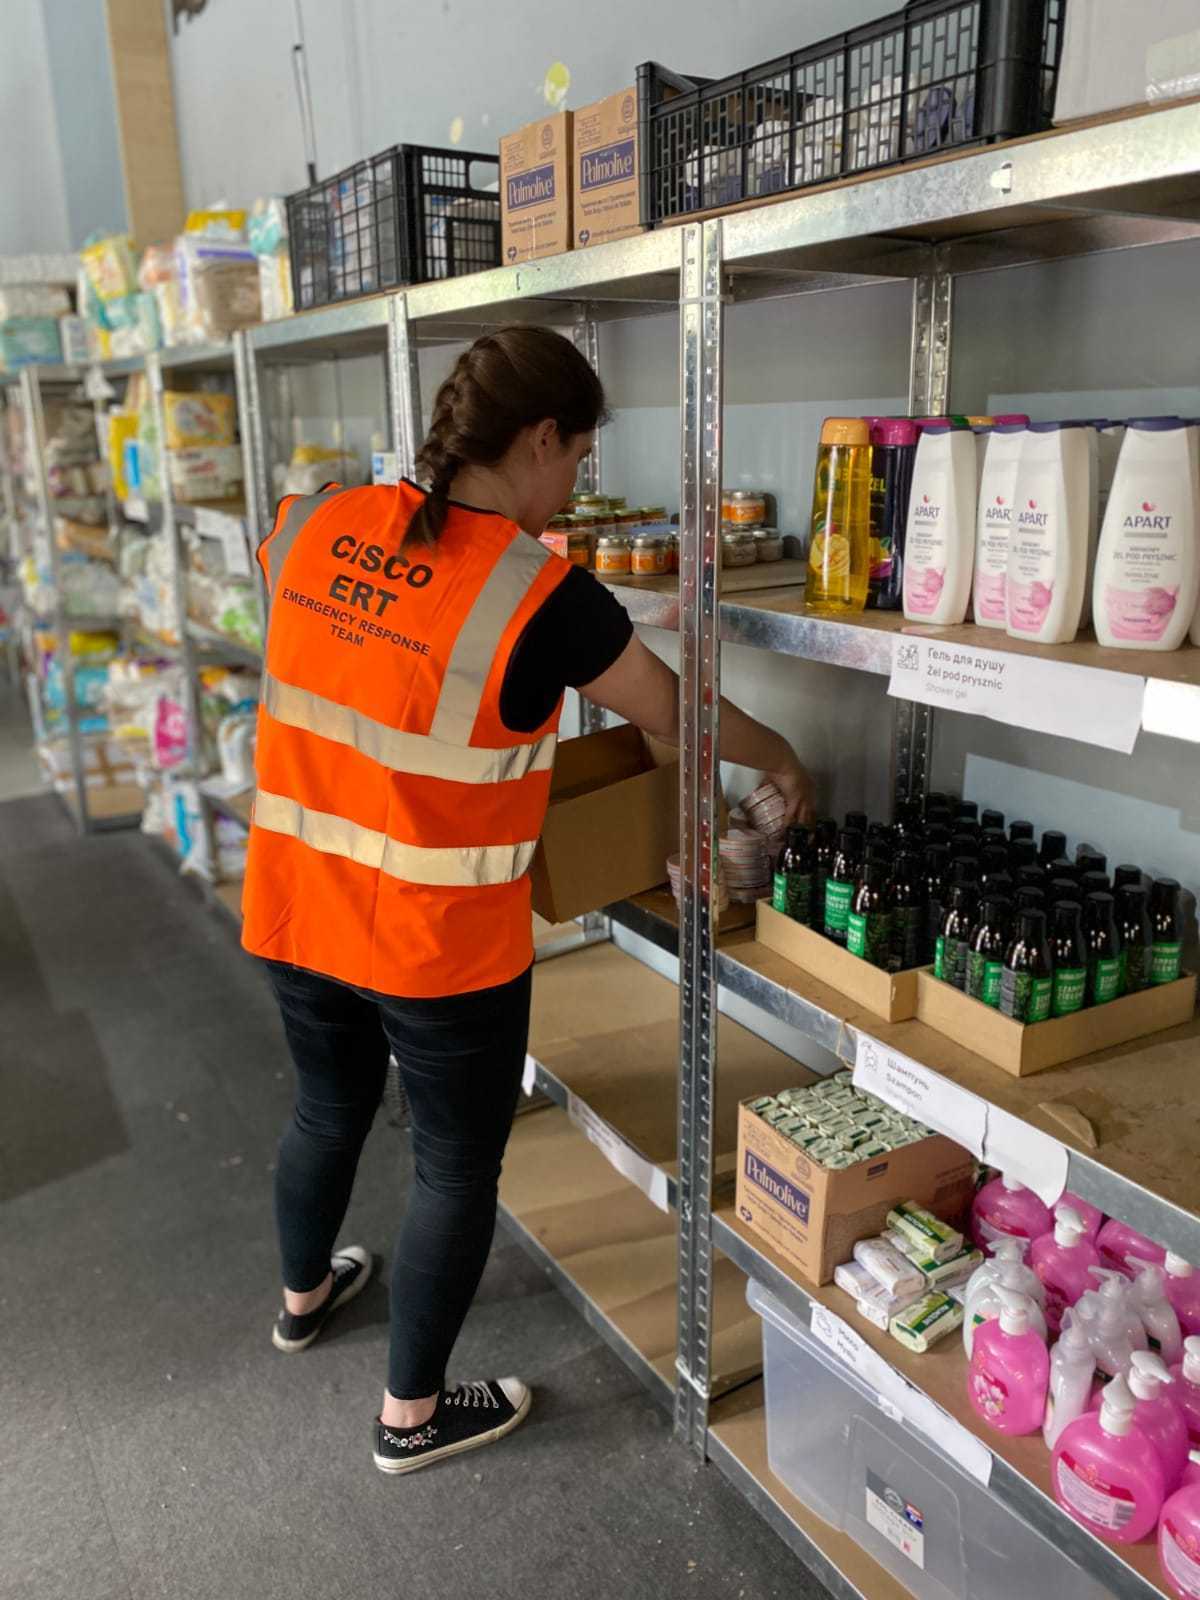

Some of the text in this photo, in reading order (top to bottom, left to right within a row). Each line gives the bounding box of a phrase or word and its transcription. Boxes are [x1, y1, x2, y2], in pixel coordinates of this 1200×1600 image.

[582, 154, 633, 185] Palmolive
[508, 174, 553, 206] Palmolive
[914, 506, 940, 519] APART
[986, 507, 1010, 520] APAR
[1018, 512, 1048, 526] APART
[1123, 515, 1172, 530] APART
[331, 534, 433, 588] CISCO
[328, 573, 399, 617] ERT
[282, 587, 431, 656] EMERGENCY RESPONSE
[330, 623, 364, 647] TEAM
[928, 647, 1005, 674] Гель для душу
[927, 663, 1003, 690] Żel pod prysznic
[747, 1154, 807, 1218] Palmolive
